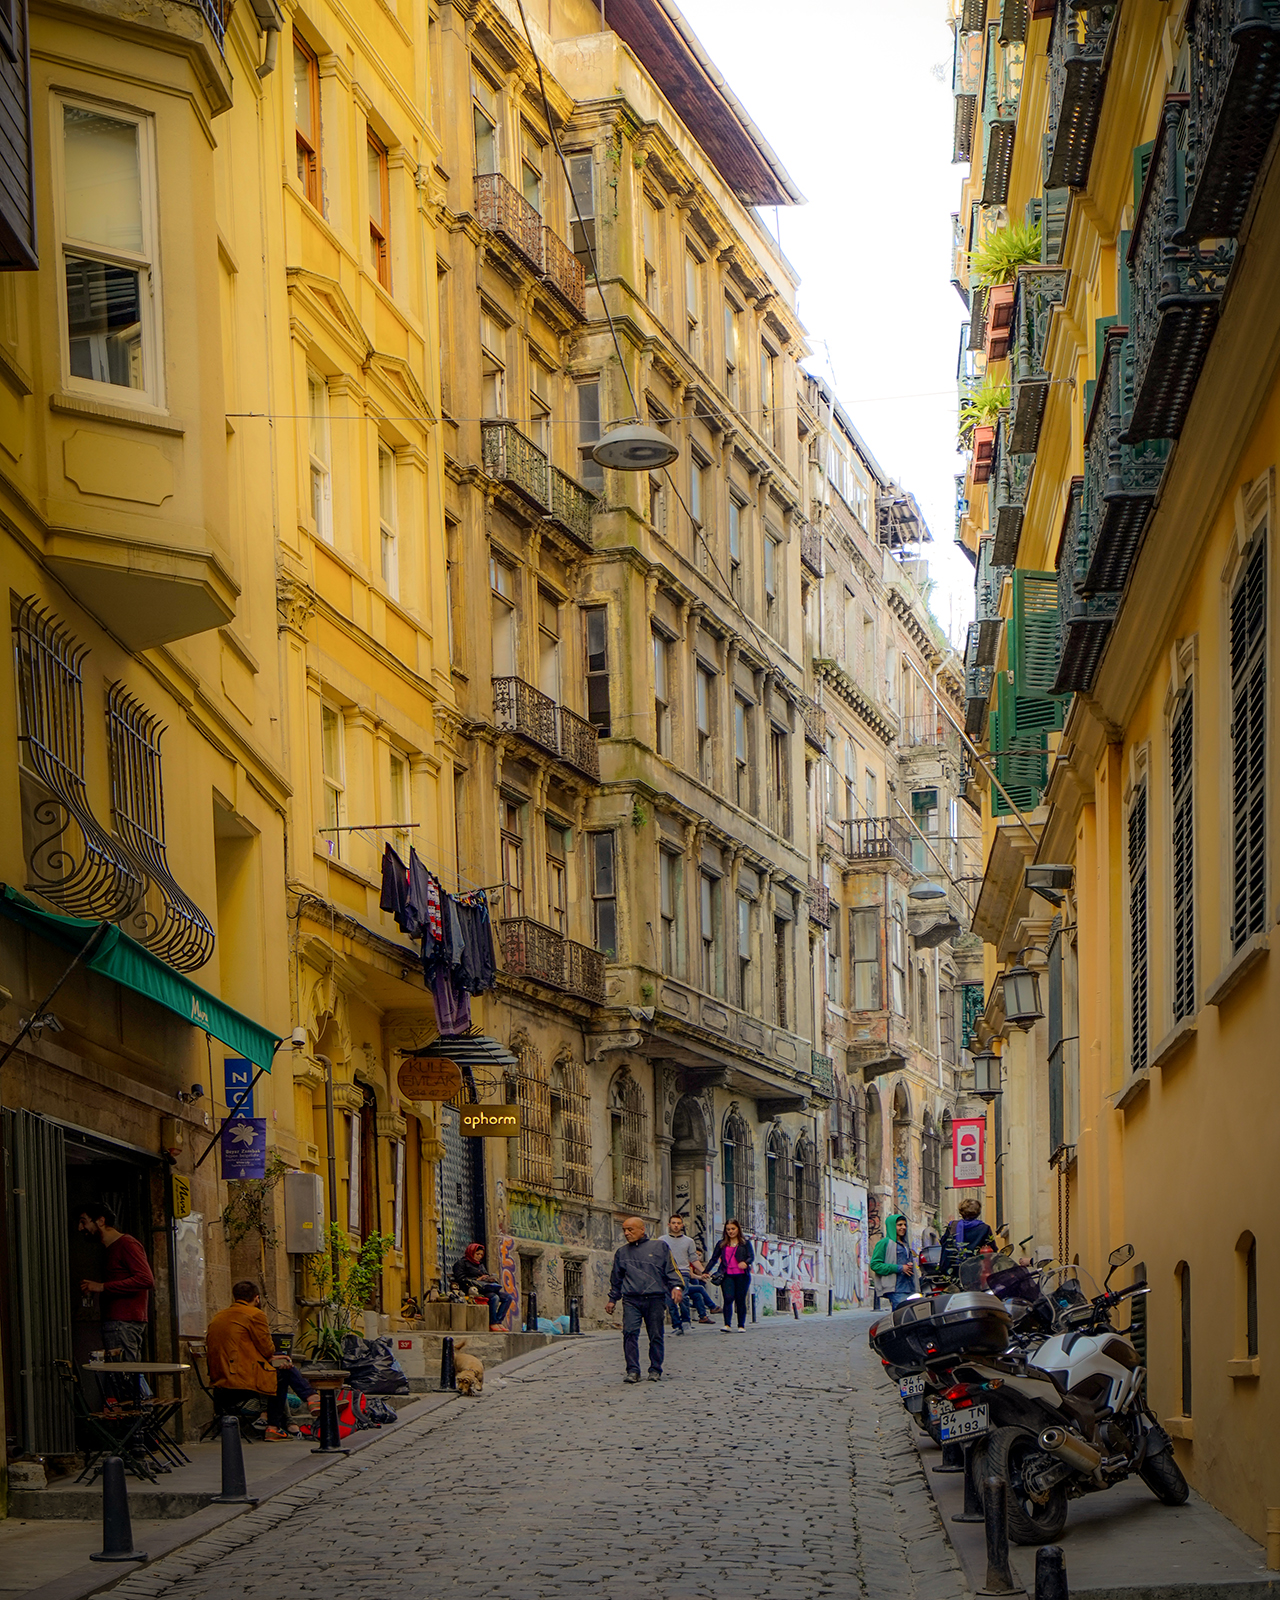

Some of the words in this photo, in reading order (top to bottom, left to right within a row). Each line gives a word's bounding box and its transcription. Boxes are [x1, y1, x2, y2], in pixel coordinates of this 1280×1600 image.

[409, 1061, 449, 1073] KULE
[402, 1074, 456, 1087] EMLAK
[463, 1111, 516, 1129] aphorm
[902, 1377, 914, 1387] 34
[908, 1383, 924, 1394] 810
[942, 1413, 957, 1426] 34
[968, 1405, 986, 1419] TN
[949, 1420, 979, 1436] 4193
